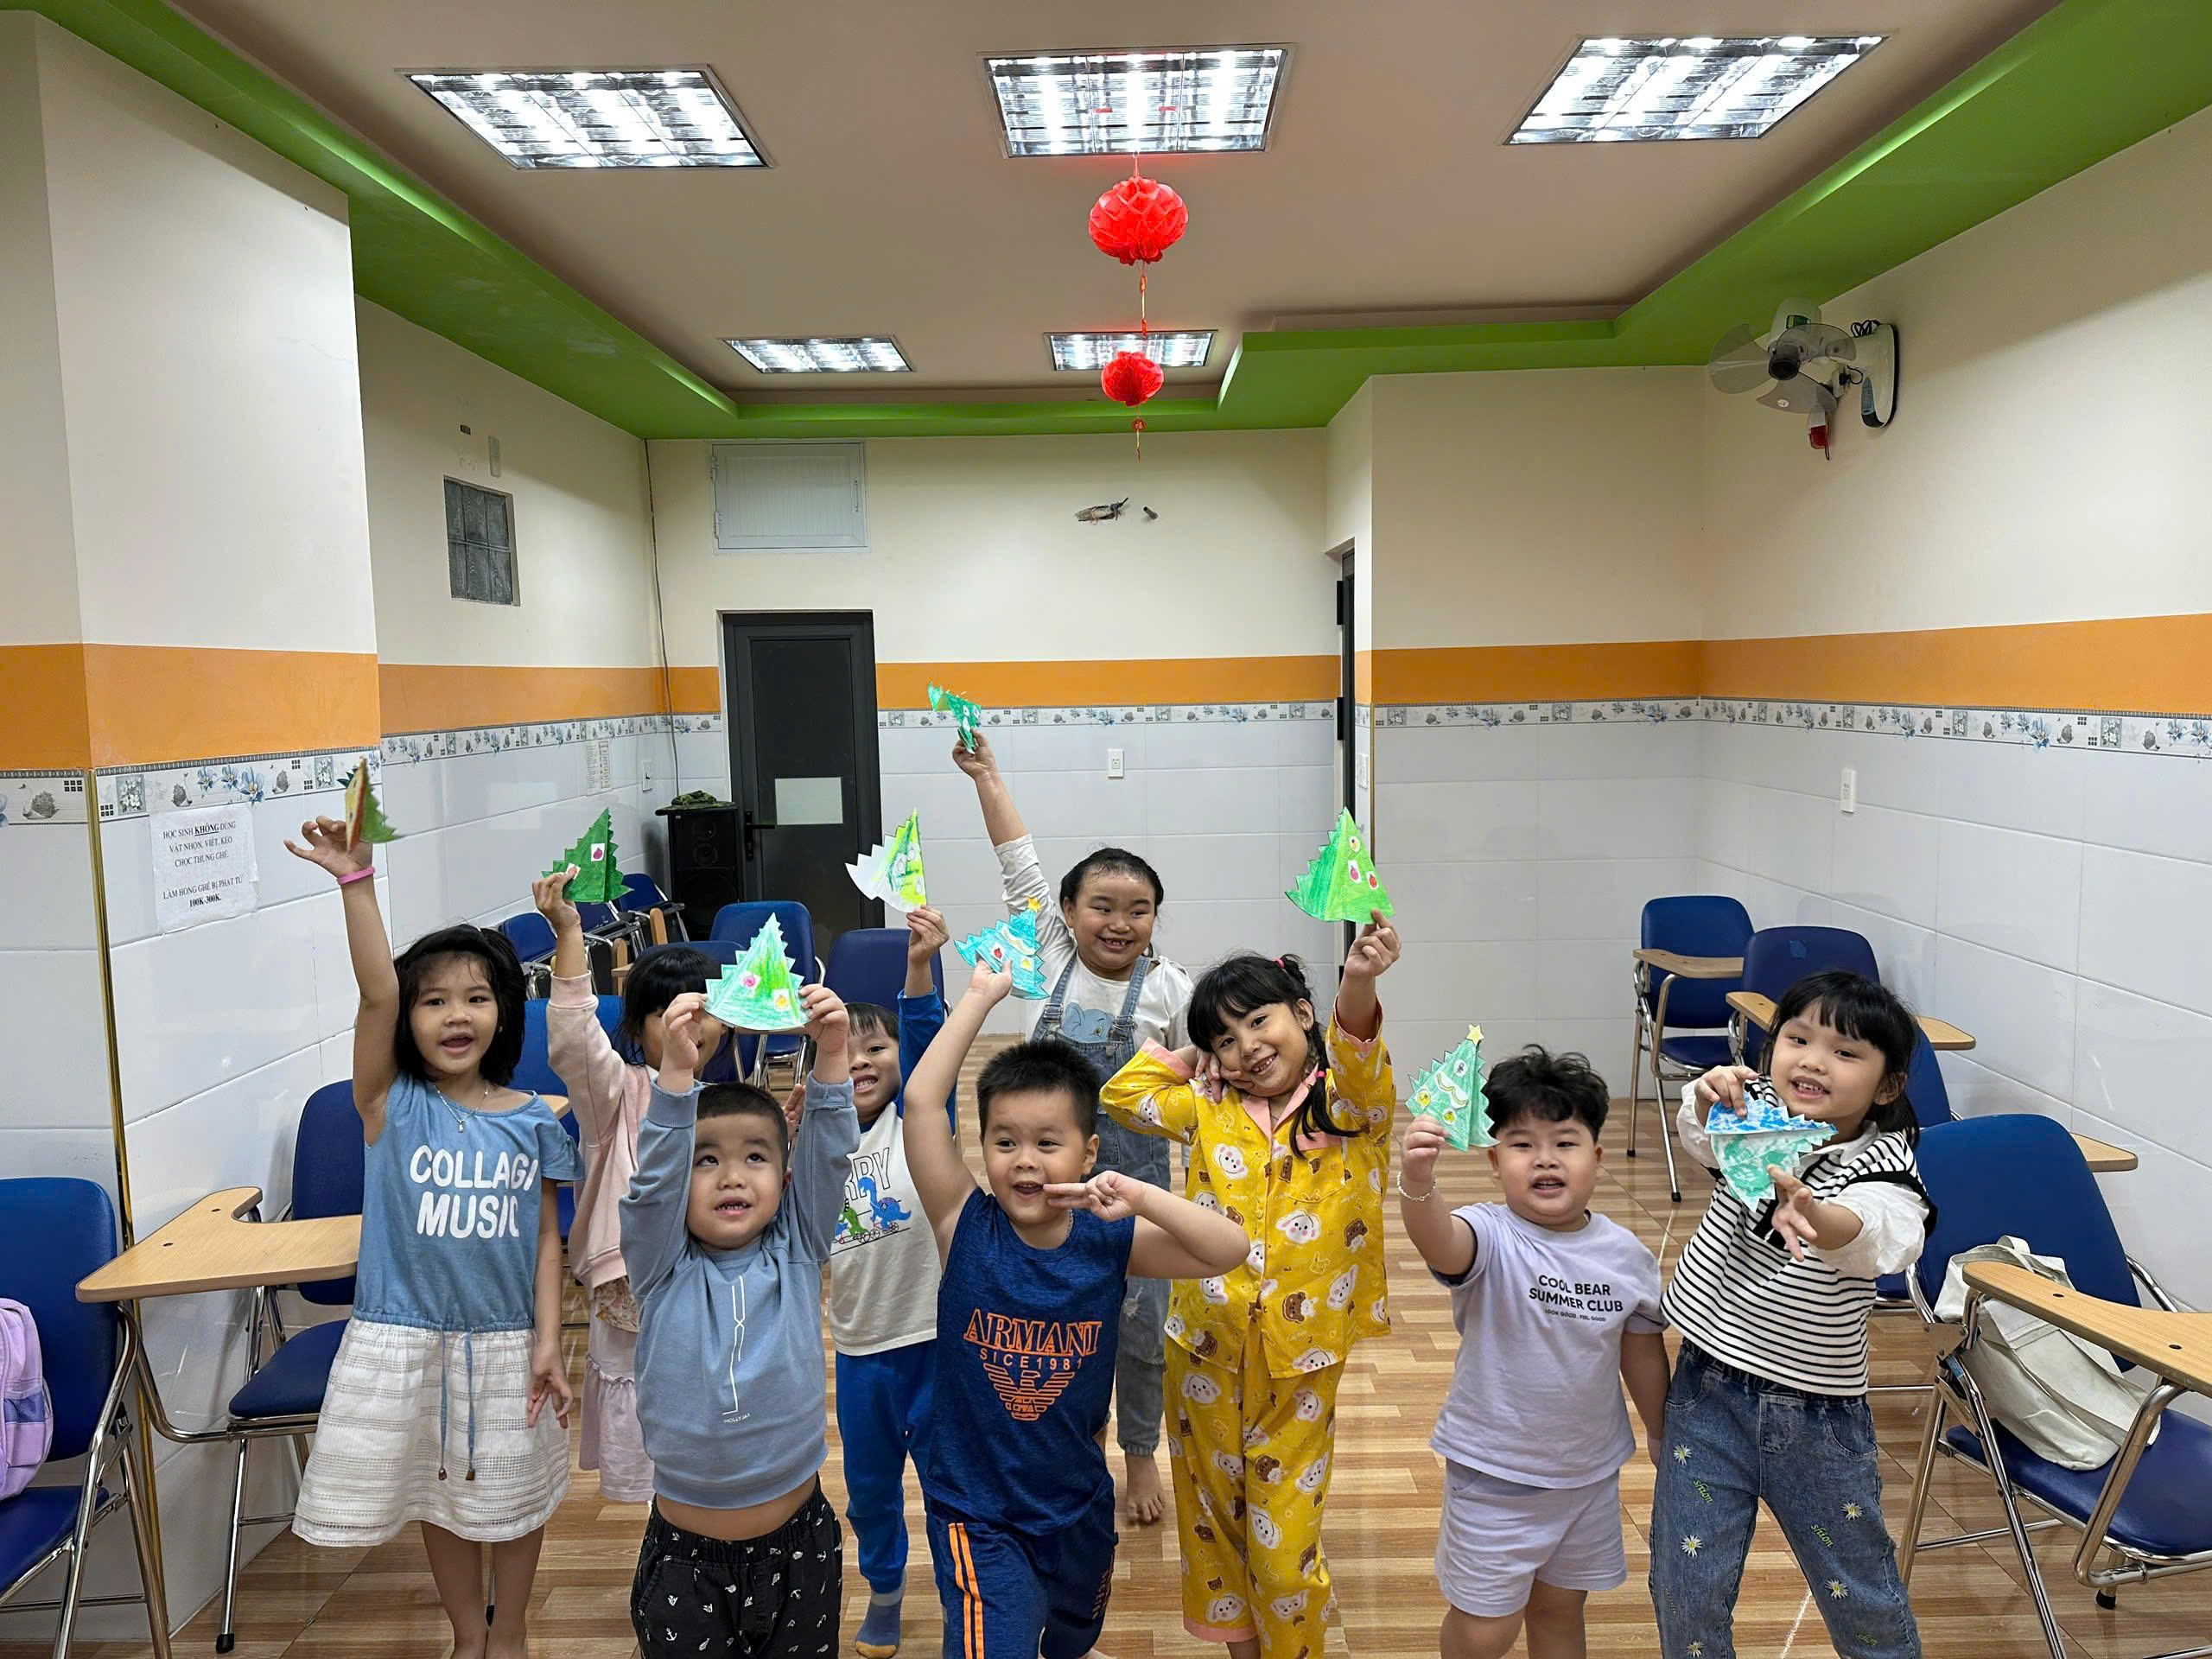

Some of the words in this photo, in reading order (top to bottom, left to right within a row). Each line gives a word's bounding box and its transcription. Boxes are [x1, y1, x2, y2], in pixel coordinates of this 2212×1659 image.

[178, 827, 194, 837] SINH
[1538, 1274, 1572, 1294] COOL
[1574, 1283, 1611, 1296] BEAR
[1529, 1287, 1584, 1310] SUMMER
[1586, 1300, 1623, 1312] CLUB
[963, 1308, 1103, 1357] ARMANI
